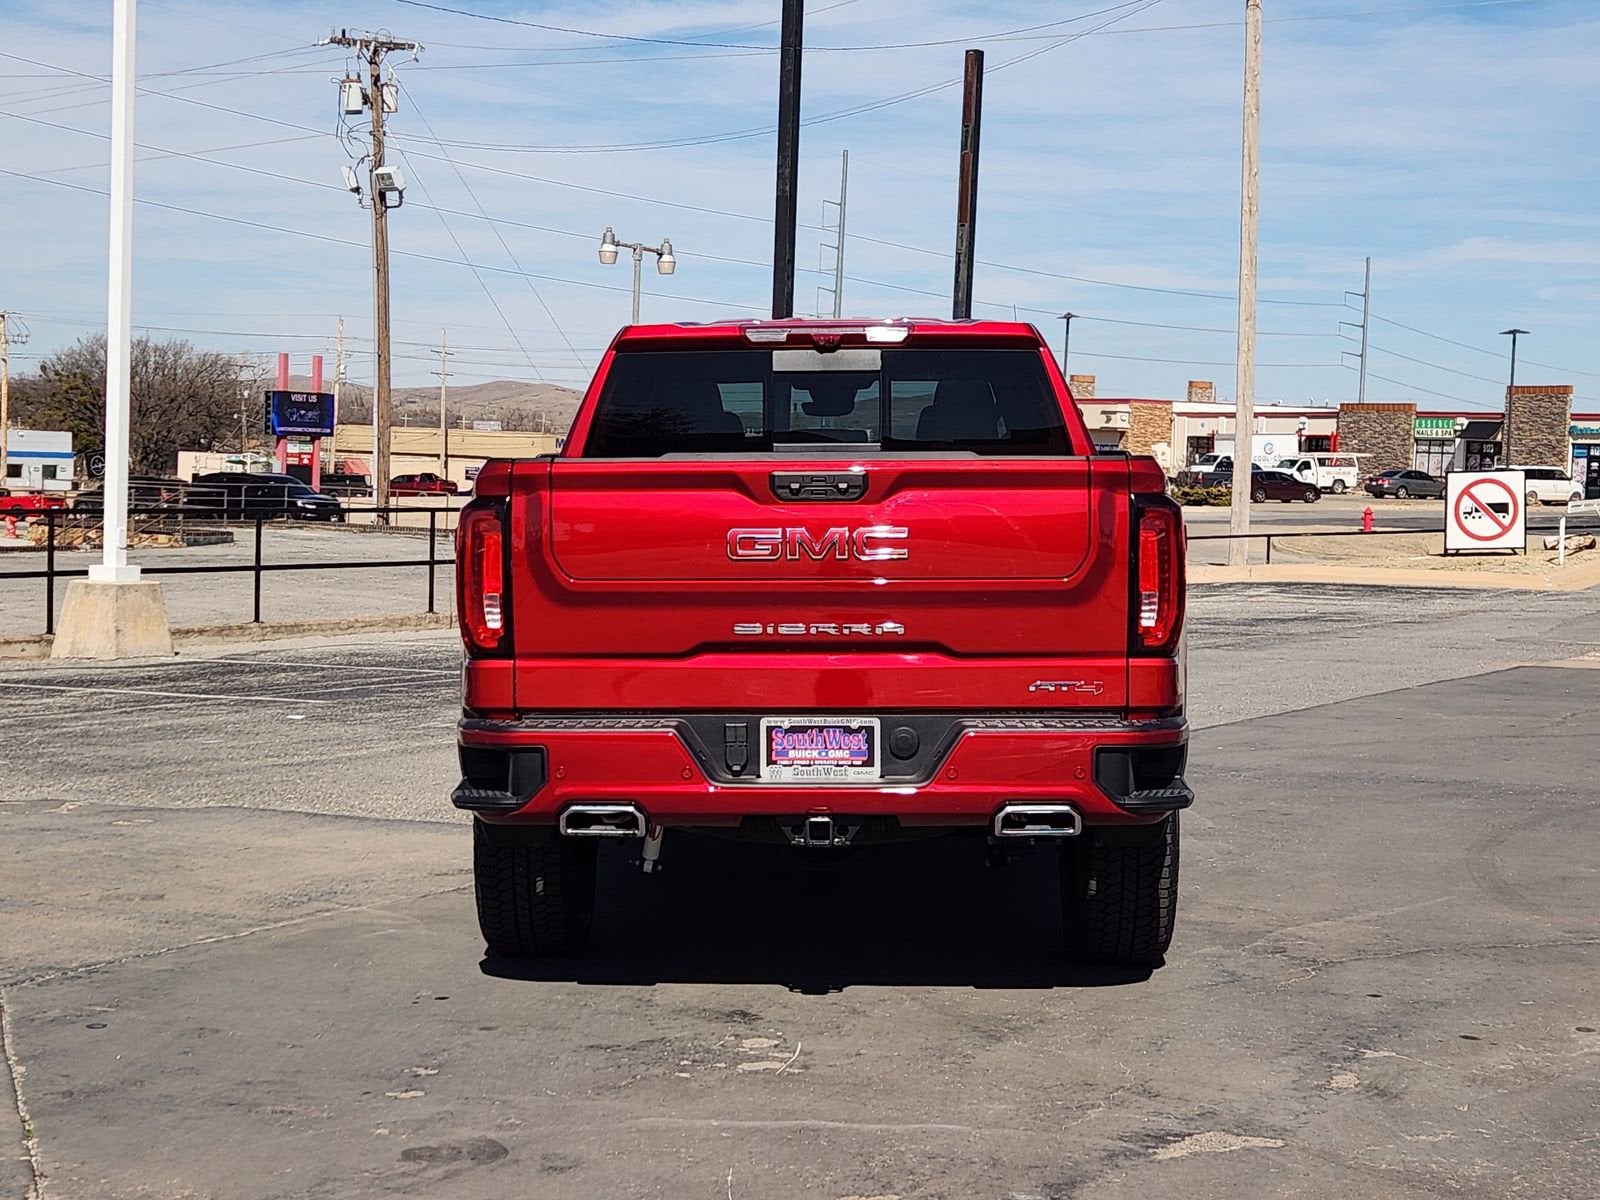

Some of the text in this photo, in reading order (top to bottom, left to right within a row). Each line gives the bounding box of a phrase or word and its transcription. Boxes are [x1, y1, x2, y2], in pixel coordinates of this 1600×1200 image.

[290, 394, 318, 403] VISIT US
[1415, 419, 1455, 428] ESSENCE
[726, 527, 909, 560] GMC
[733, 623, 905, 635] SIERRA
[1028, 680, 1104, 695] AT4
[788, 749, 850, 758] BUICK GMC
